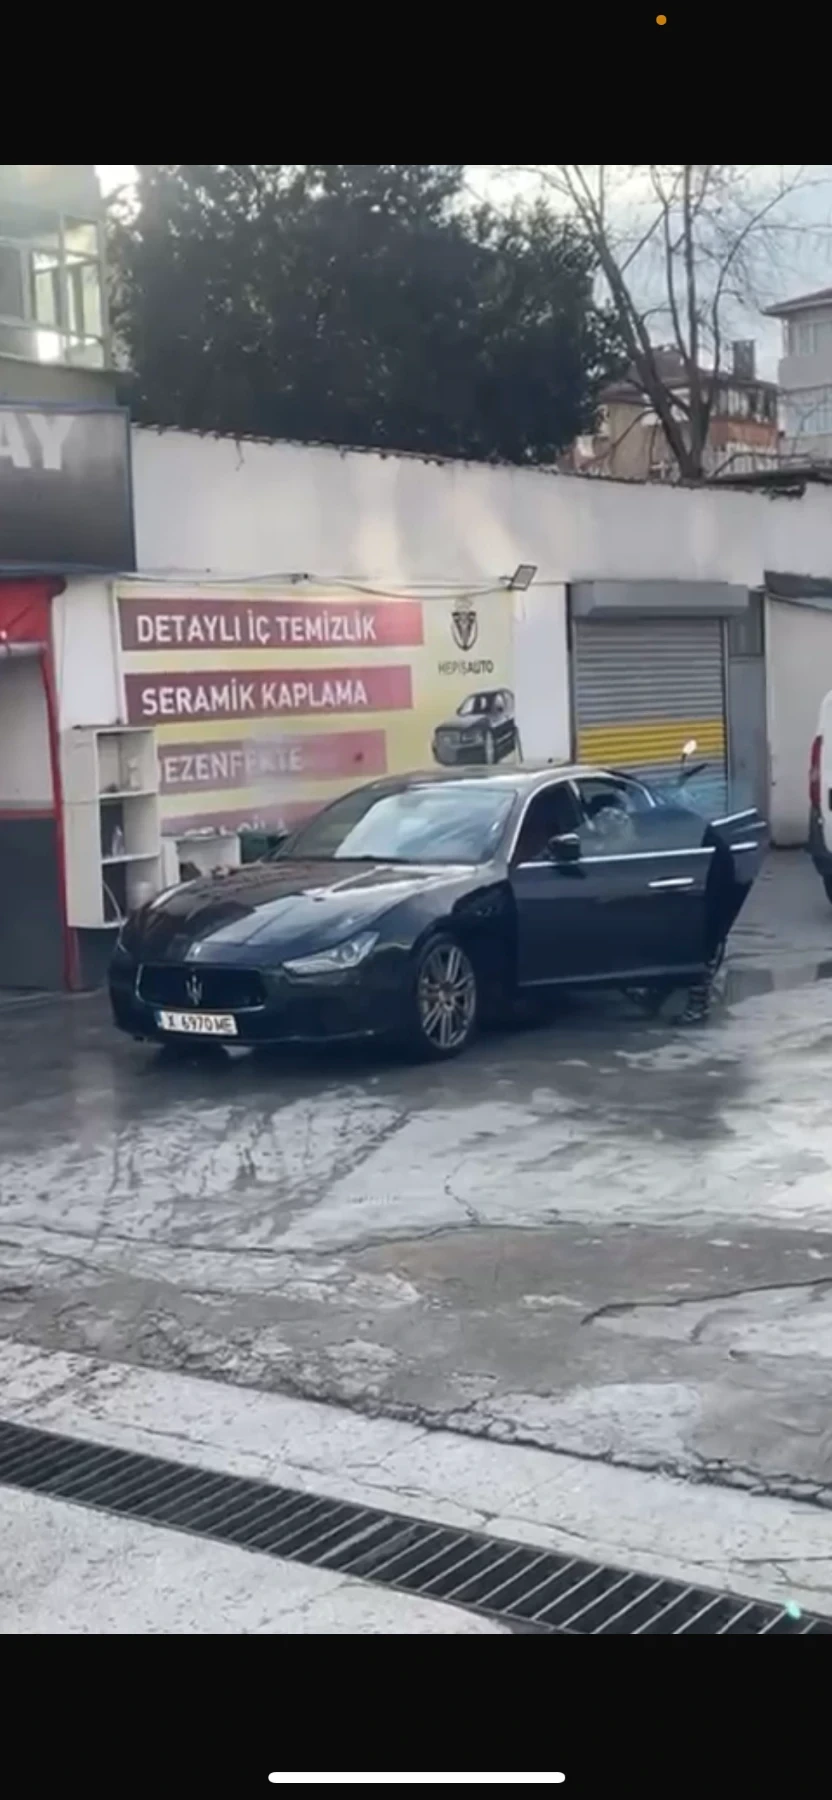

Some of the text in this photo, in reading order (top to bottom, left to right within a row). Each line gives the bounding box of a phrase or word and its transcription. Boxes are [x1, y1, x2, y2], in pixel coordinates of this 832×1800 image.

[136, 610, 377, 644] DETAYLI İÇ TEMİZLİK
[141, 678, 368, 716] SERAMİK KAPLAMA
